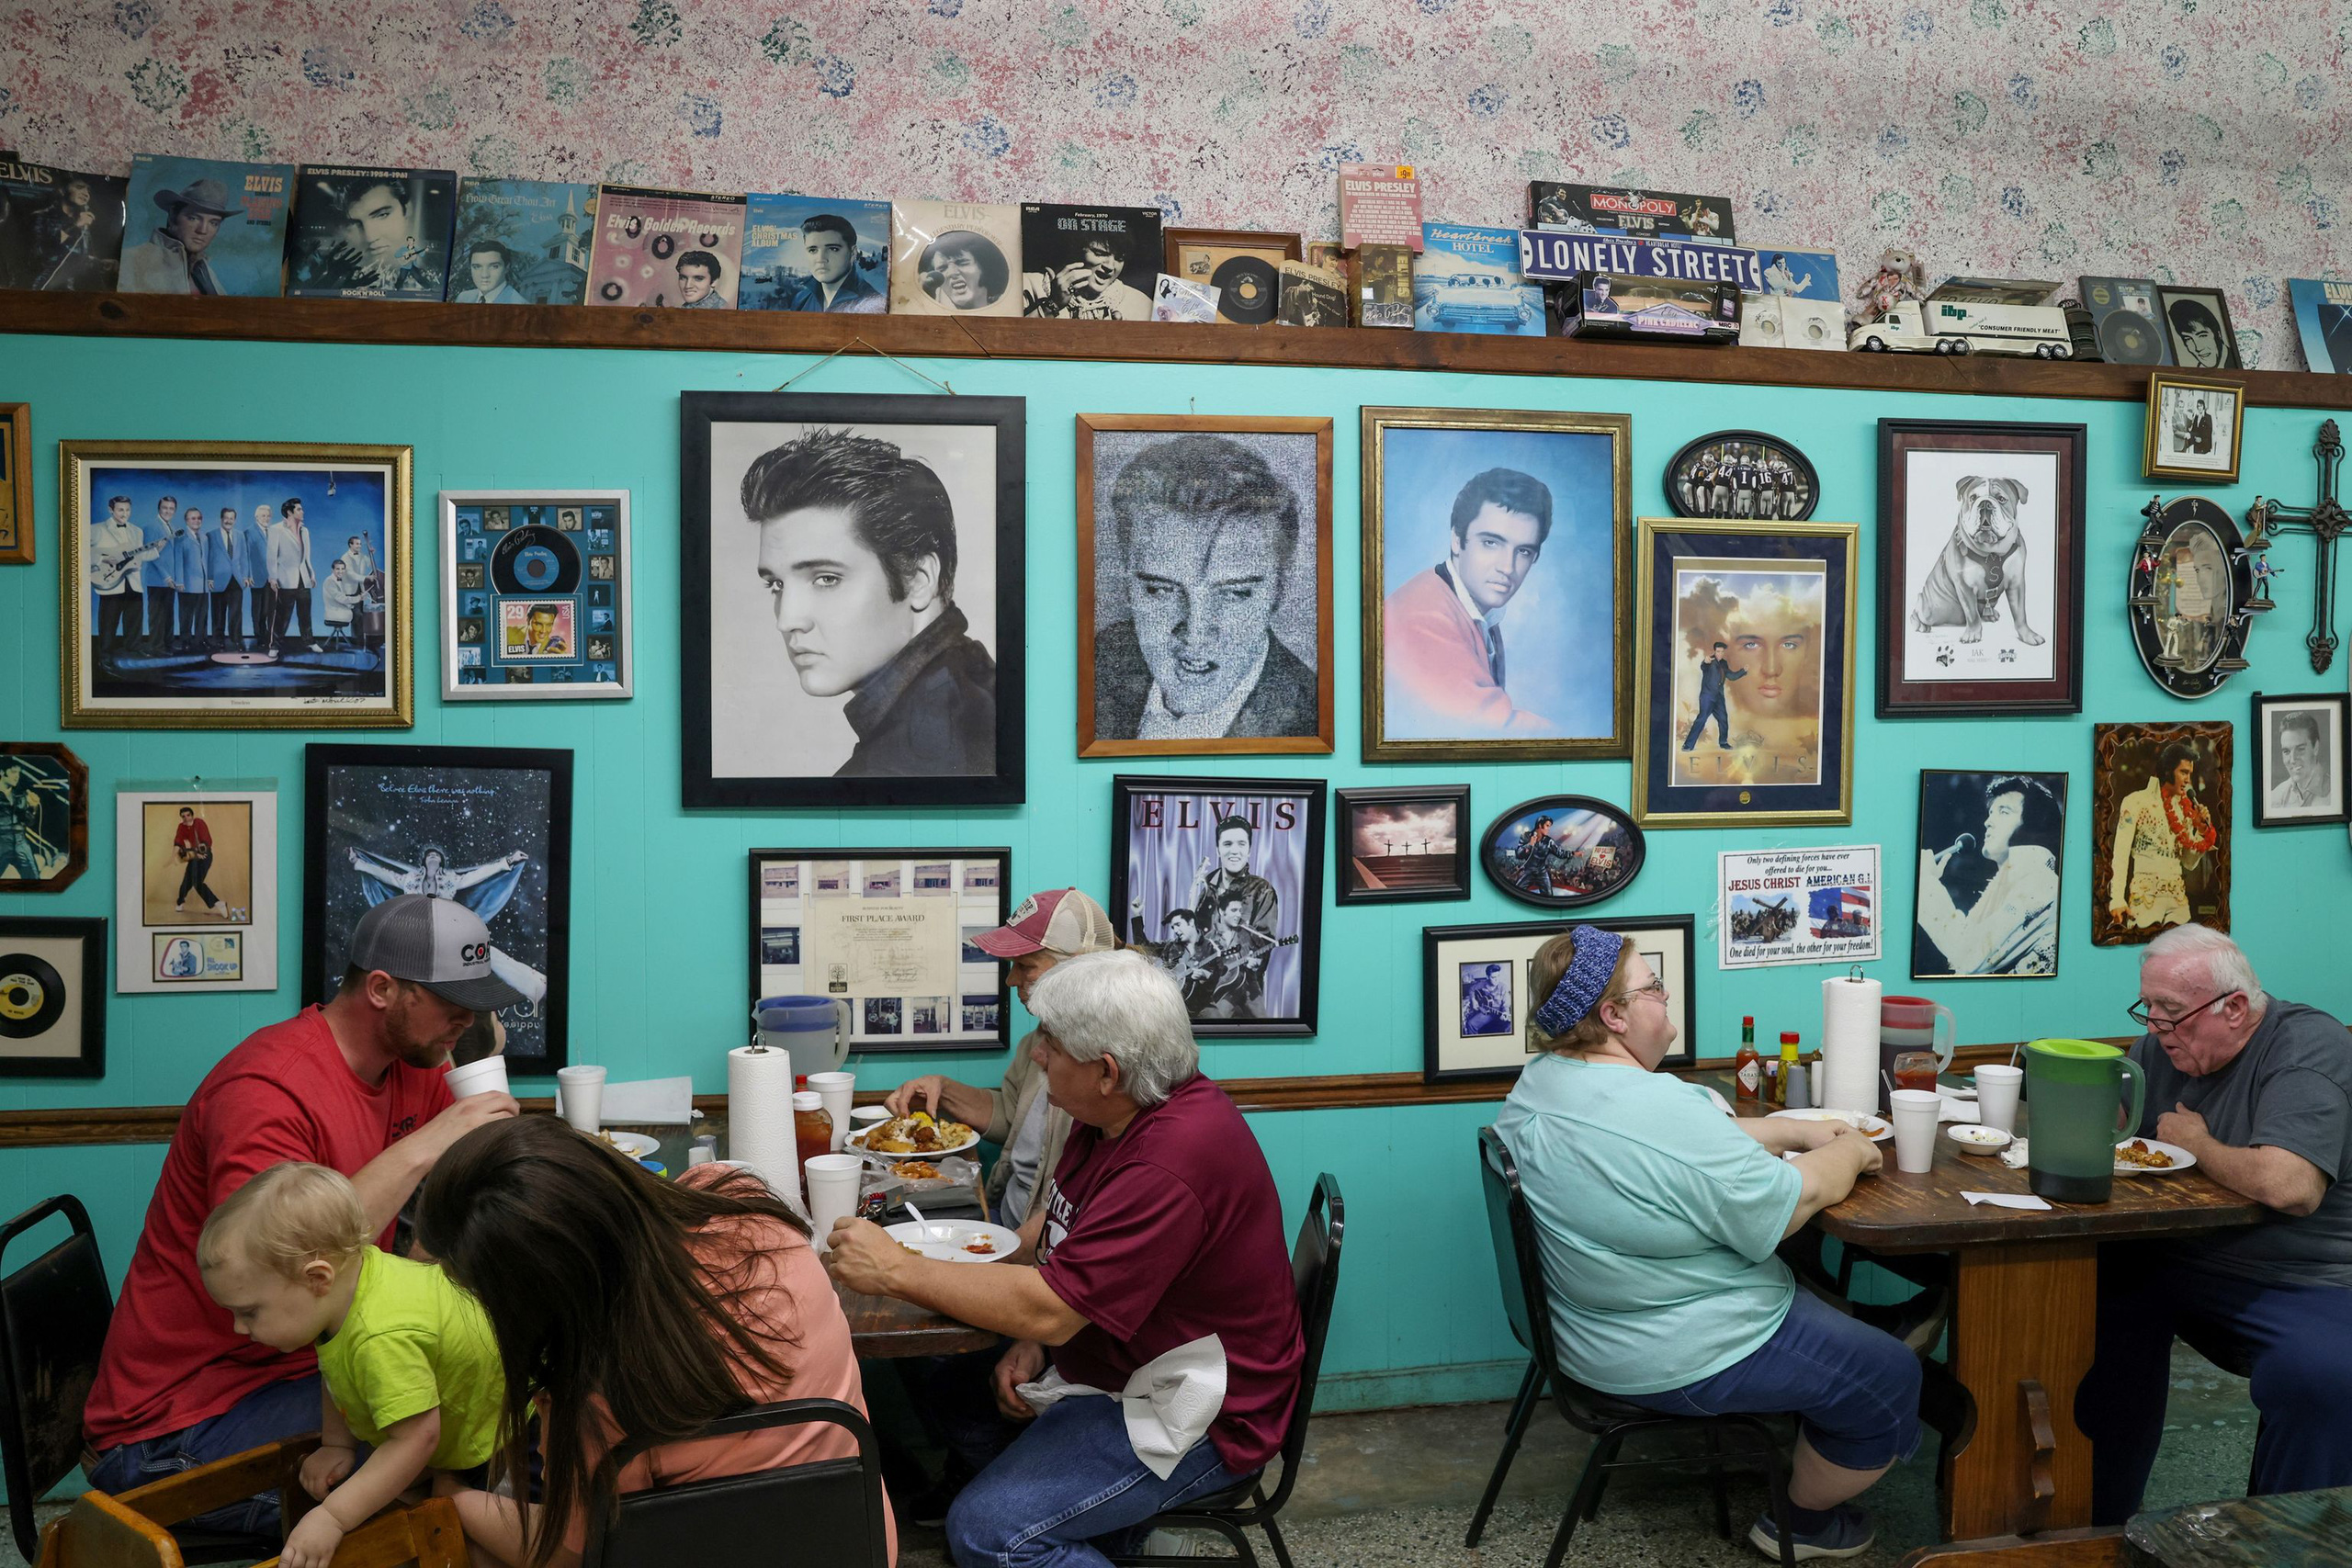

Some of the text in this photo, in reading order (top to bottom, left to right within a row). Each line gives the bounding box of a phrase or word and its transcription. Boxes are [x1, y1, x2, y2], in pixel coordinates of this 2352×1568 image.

[0, 162, 52, 184] ELVIS
[307, 167, 330, 175] ELVIS
[331, 169, 369, 177] PRESLEY:
[244, 175, 283, 193] ELVIS
[1345, 179, 1416, 194] ELVIS PRESLEY
[466, 192, 487, 203] How
[488, 194, 513, 205] Great
[514, 195, 538, 206] Thou
[1592, 196, 1675, 215] MONOPOLY
[944, 205, 989, 220] ELVIS
[643, 216, 686, 233] Golden
[687, 220, 736, 236] Records
[1057, 218, 1126, 233] ON STAGE
[1617, 214, 1655, 231] ELVIS
[751, 239, 779, 247] ALBUM
[752, 231, 797, 240] CHRISTMAS
[1430, 228, 1513, 244] Heartbreak
[1452, 242, 1495, 254] HOTEL
[1537, 239, 1745, 283] LONELY STREET
[1284, 266, 1341, 289] ELVIS PRESLEY
[1312, 291, 1326, 299] Hound
[1941, 304, 1967, 321] ibp
[1638, 315, 1699, 329] PINK CADILLAC
[1741, 471, 1747, 484] 1
[1759, 471, 1772, 484] 16
[1781, 471, 1793, 485] 47
[1989, 566, 1999, 582] S
[506, 604, 525, 620] 29
[562, 604, 571, 620] USA
[507, 644, 526, 654] ELVIS
[1689, 755, 1808, 775] ELVIS
[407, 784, 427, 793] Elvis
[428, 784, 449, 794] there
[1141, 800, 1296, 830] ELVIS
[1590, 857, 1612, 867] ELVIS
[1747, 856, 1761, 865] Only
[1775, 854, 1801, 865] defining
[1801, 853, 1820, 863] forces
[1765, 866, 1787, 876] offered
[1805, 865, 1815, 874] for
[1728, 876, 1802, 891] JESUS CHRIST
[1805, 873, 1873, 887] AMERICAN G.I.
[842, 914, 925, 922] FIRST PLACE AWARD
[1729, 939, 1873, 959] One died for your soul, the other for your freedom!
